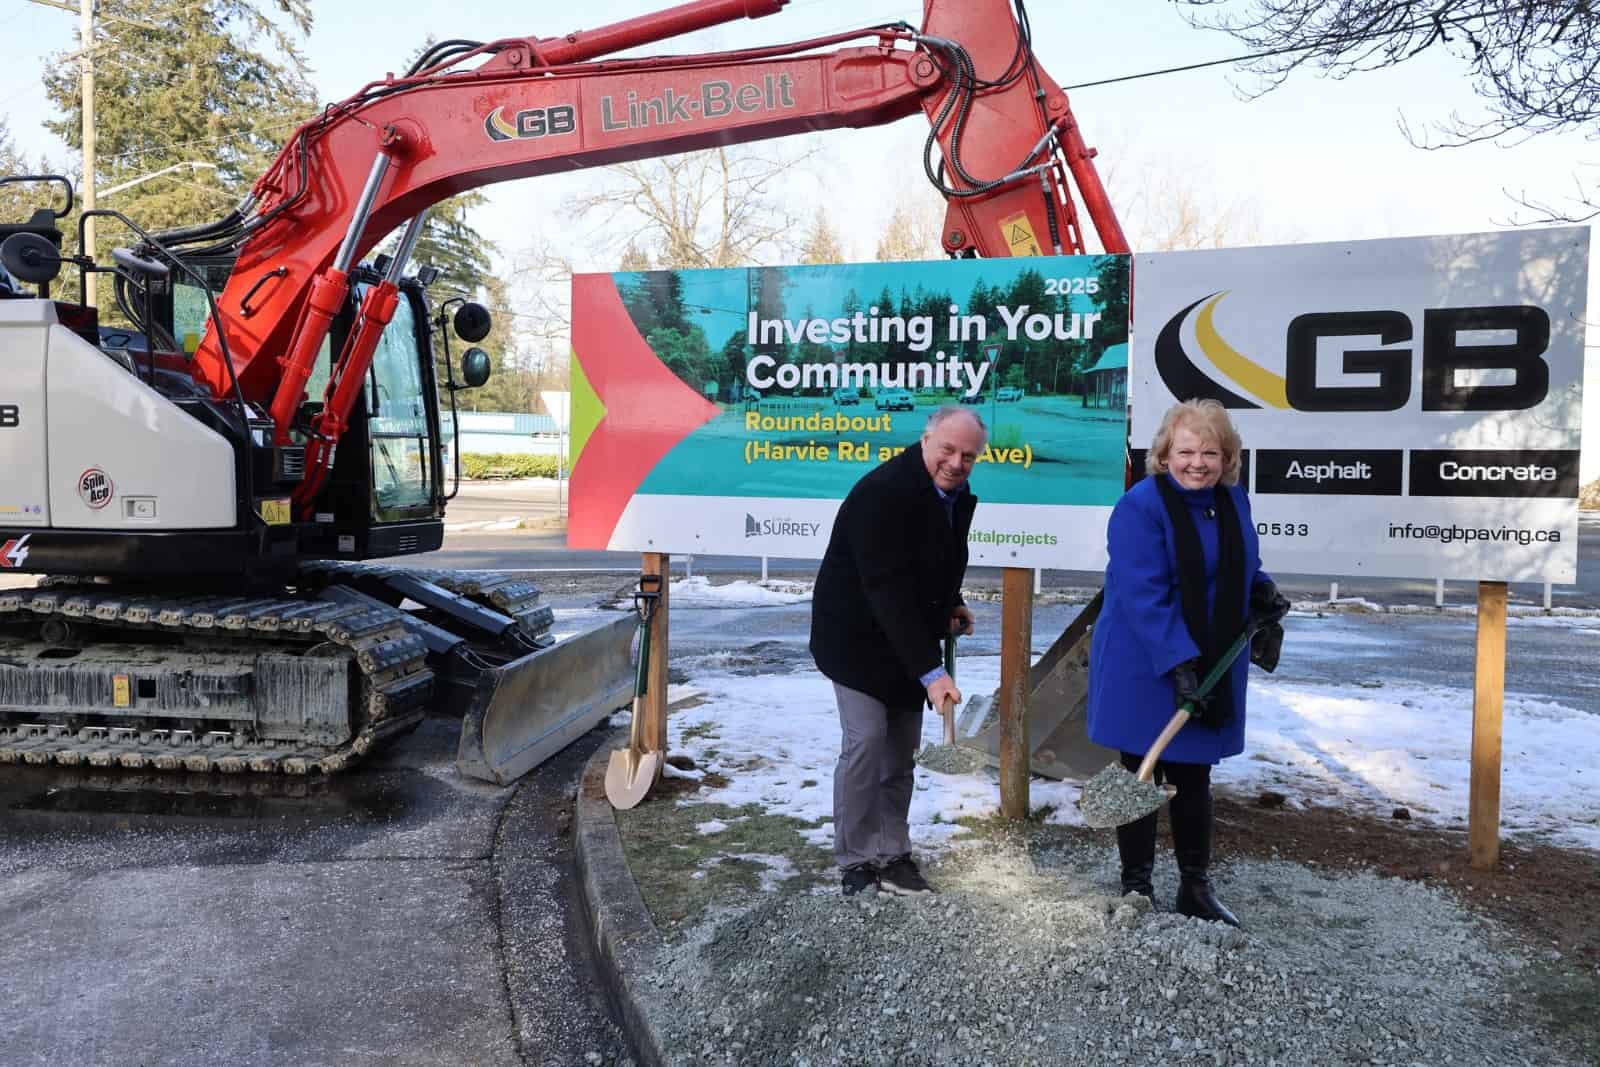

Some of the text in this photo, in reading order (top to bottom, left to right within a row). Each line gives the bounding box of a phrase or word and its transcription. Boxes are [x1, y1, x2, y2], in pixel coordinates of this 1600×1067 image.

[601, 74, 795, 132] Link-Belt
[516, 105, 576, 138] GB
[1044, 277, 1099, 296] 2025
[748, 304, 1101, 351] Investing in Your
[1286, 305, 1550, 412] GB
[746, 351, 989, 397] Community
[745, 411, 892, 432] Roundabout
[744, 440, 829, 464] (Harvie
[838, 441, 869, 461] Rd
[976, 444, 1033, 469] Ave)
[1285, 460, 1371, 484] Asphalt
[1439, 461, 1557, 482] Concrete
[763, 519, 821, 536] SURREY
[1256, 523, 1309, 536] 0533
[1389, 523, 1561, 545] info@gbpaving.ca
